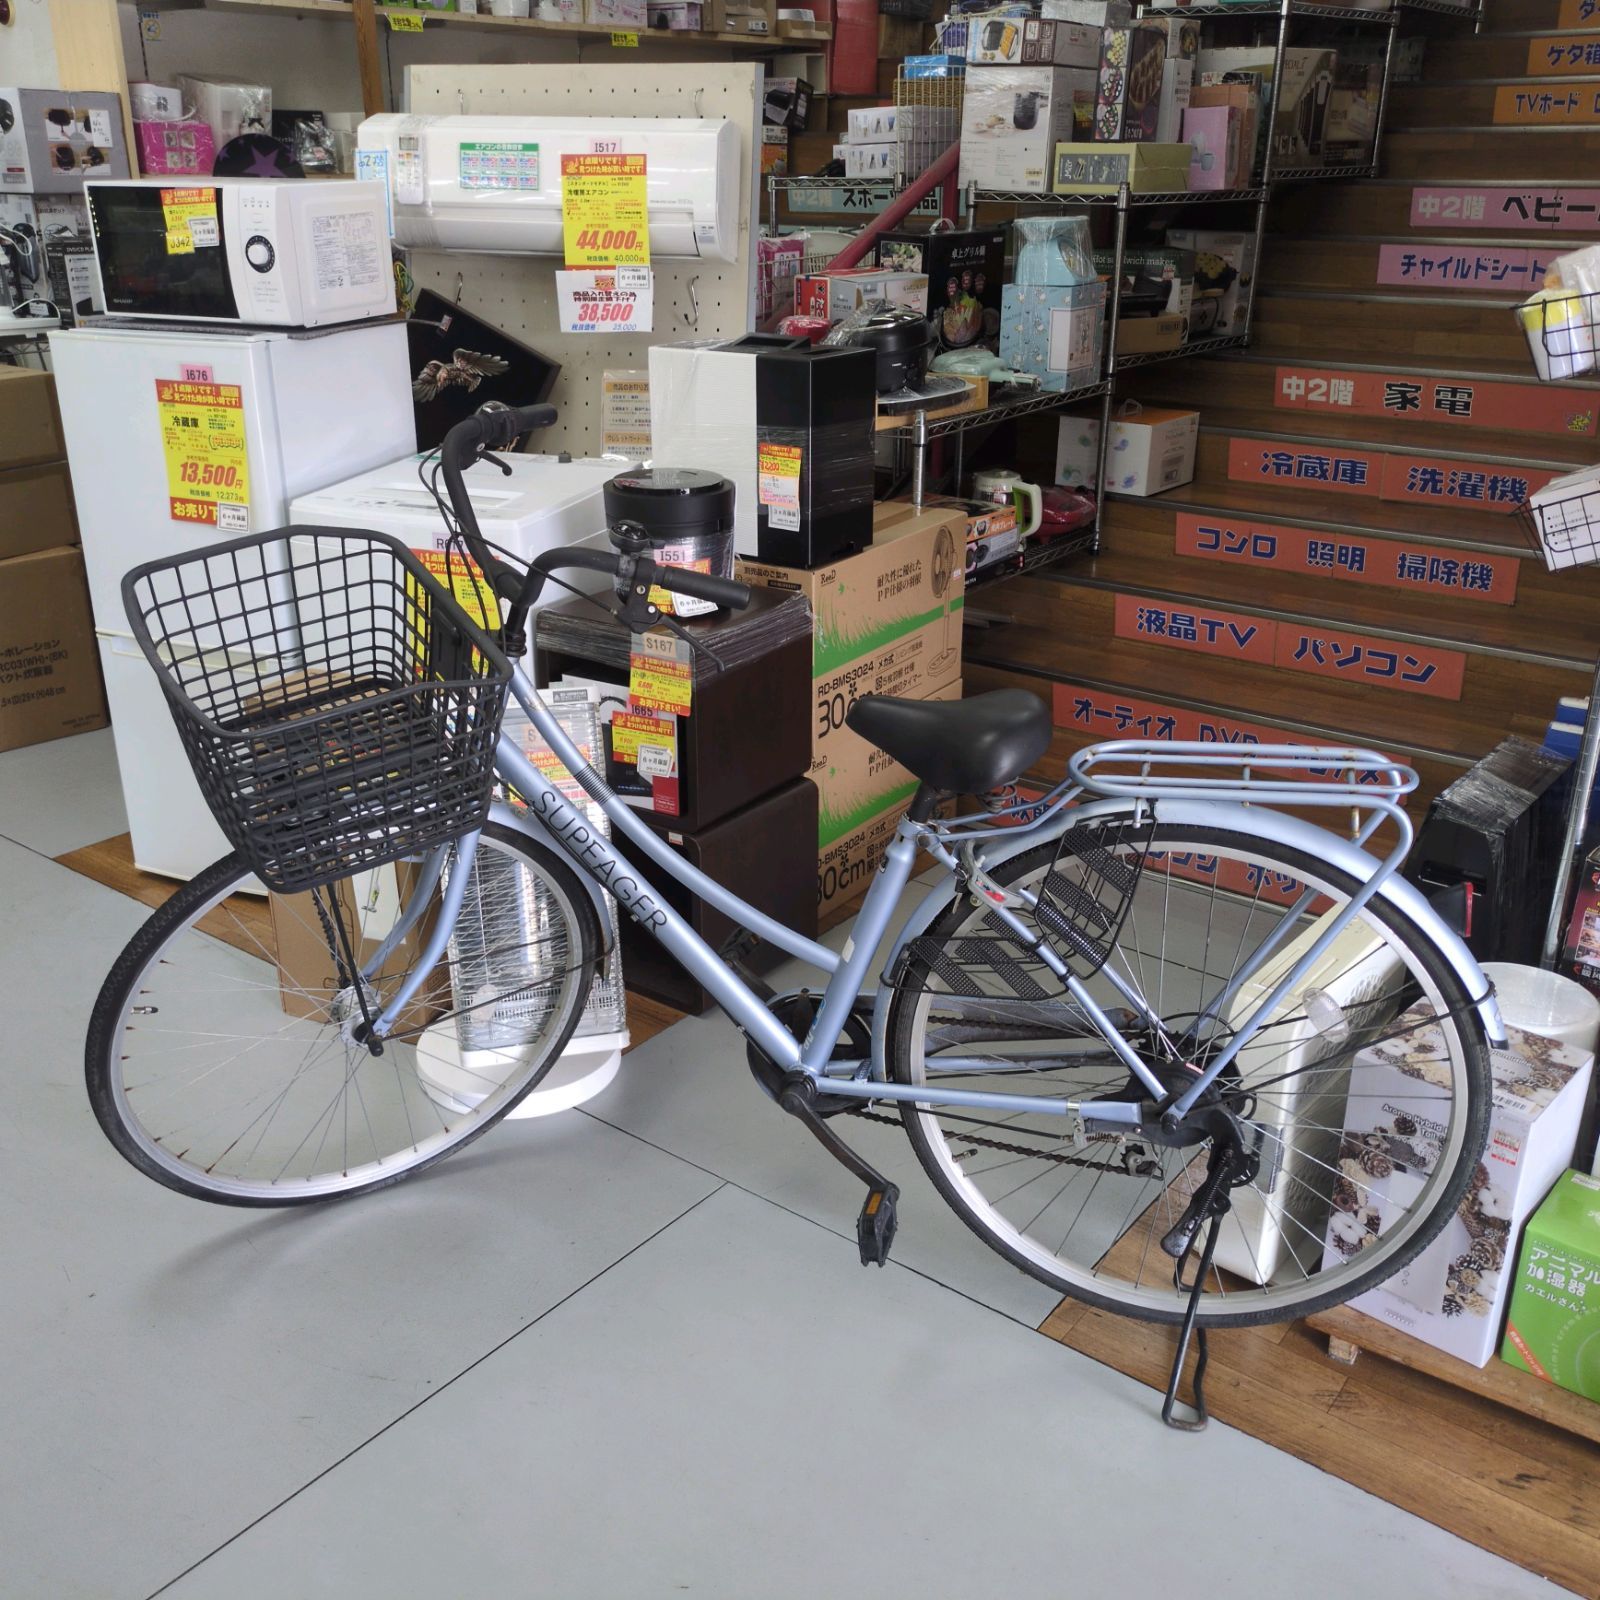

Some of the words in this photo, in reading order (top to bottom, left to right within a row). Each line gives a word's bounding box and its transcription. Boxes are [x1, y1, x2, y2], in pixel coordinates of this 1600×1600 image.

[1547, 44, 1600, 66] ゲタ箱
[1515, 92, 1582, 114] TVボード
[1418, 194, 1487, 221] 中2階
[1502, 194, 1600, 223] ベビー
[1401, 254, 1547, 282] チャイルドシート
[578, 303, 634, 323] 38,500
[1282, 375, 1354, 406] 中2階
[172, 415, 199, 428] 冷蔵庫
[1260, 451, 1369, 487] 冷蔵庫
[1404, 465, 1529, 506] 洗濯機
[744, 566, 789, 581] 別売品のご案内
[877, 559, 923, 588] 耐久性に優れた
[1195, 526, 1278, 560] コンロ
[1306, 539, 1367, 573] 照明
[1396, 551, 1494, 592] 掃除機
[1136, 606, 1257, 649] 液晶TV
[1293, 636, 1437, 685] パソコン
[877, 653, 895, 670] メカ式
[1073, 697, 1177, 741] オーディオ
[1381, 1103, 1412, 1120] Aroma
[1414, 1111, 1443, 1132] Hybrid
[1530, 1246, 1600, 1285] アニマル
